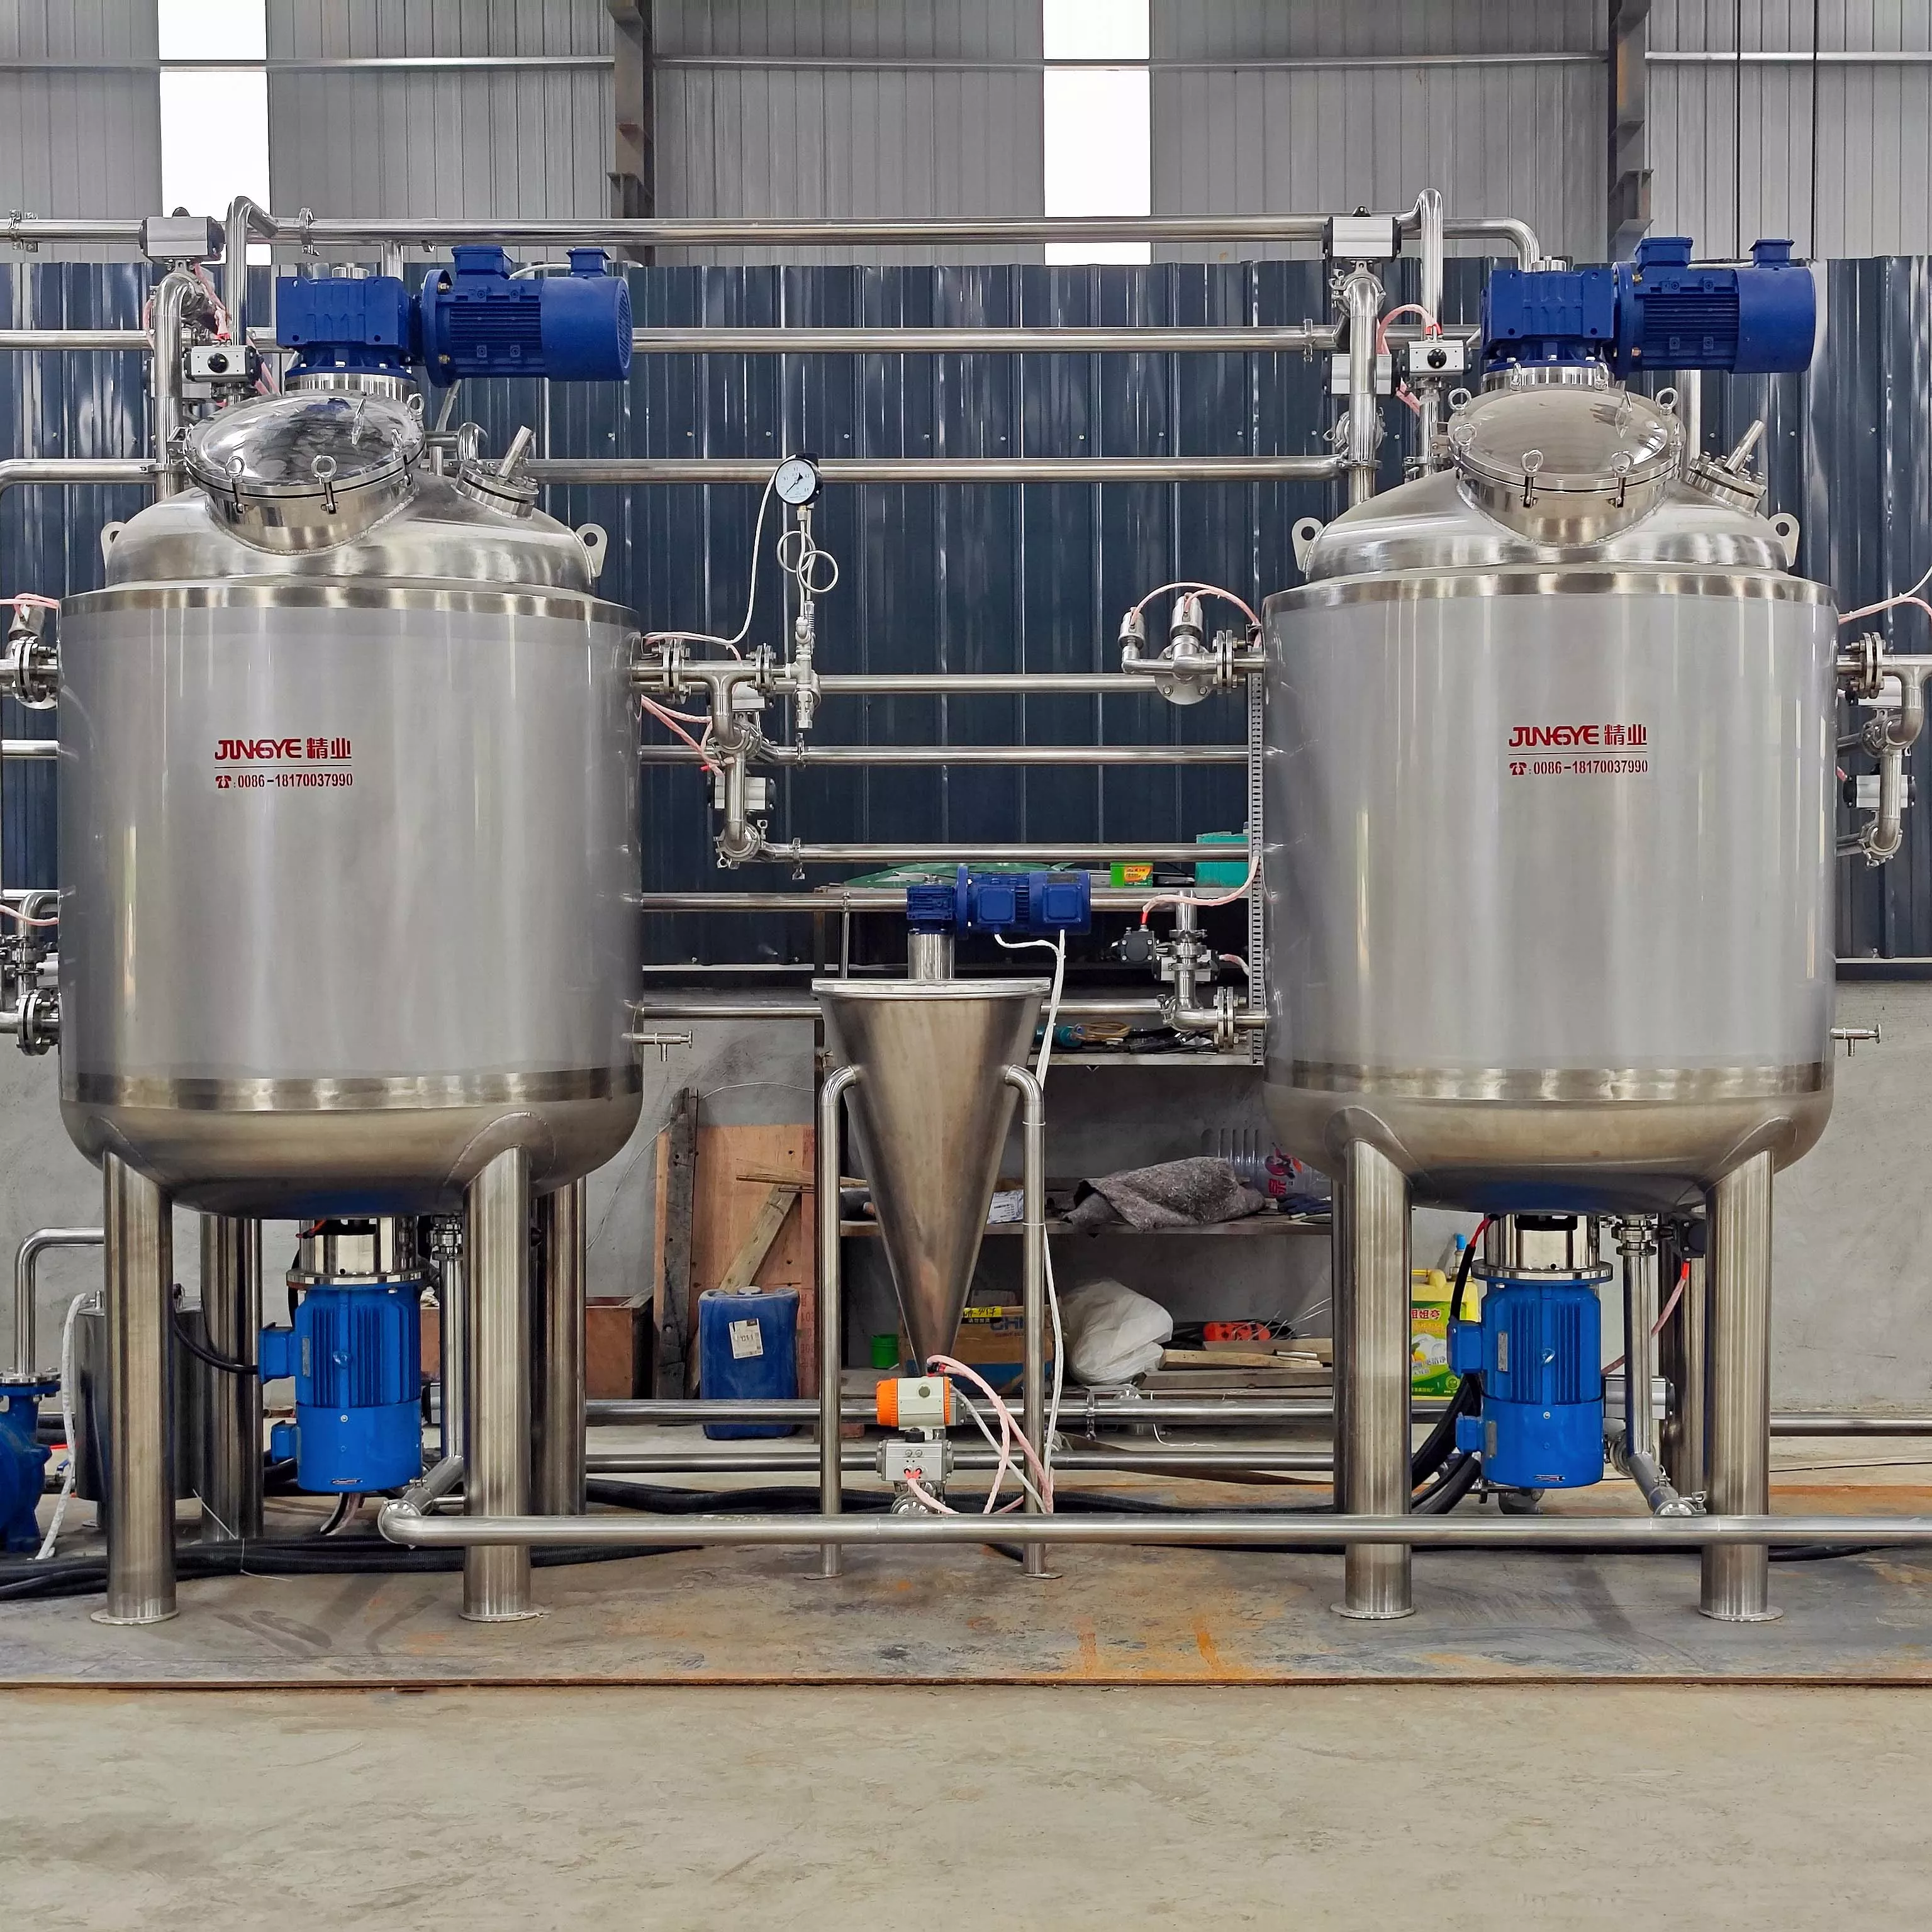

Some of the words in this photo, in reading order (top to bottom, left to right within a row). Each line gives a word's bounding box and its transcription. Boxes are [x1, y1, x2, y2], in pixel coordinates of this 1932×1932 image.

[1508, 725, 1599, 747] JINGYE
[1604, 723, 1648, 745] 精业
[214, 739, 302, 761] JINGYE
[306, 737, 352, 759] 精业
